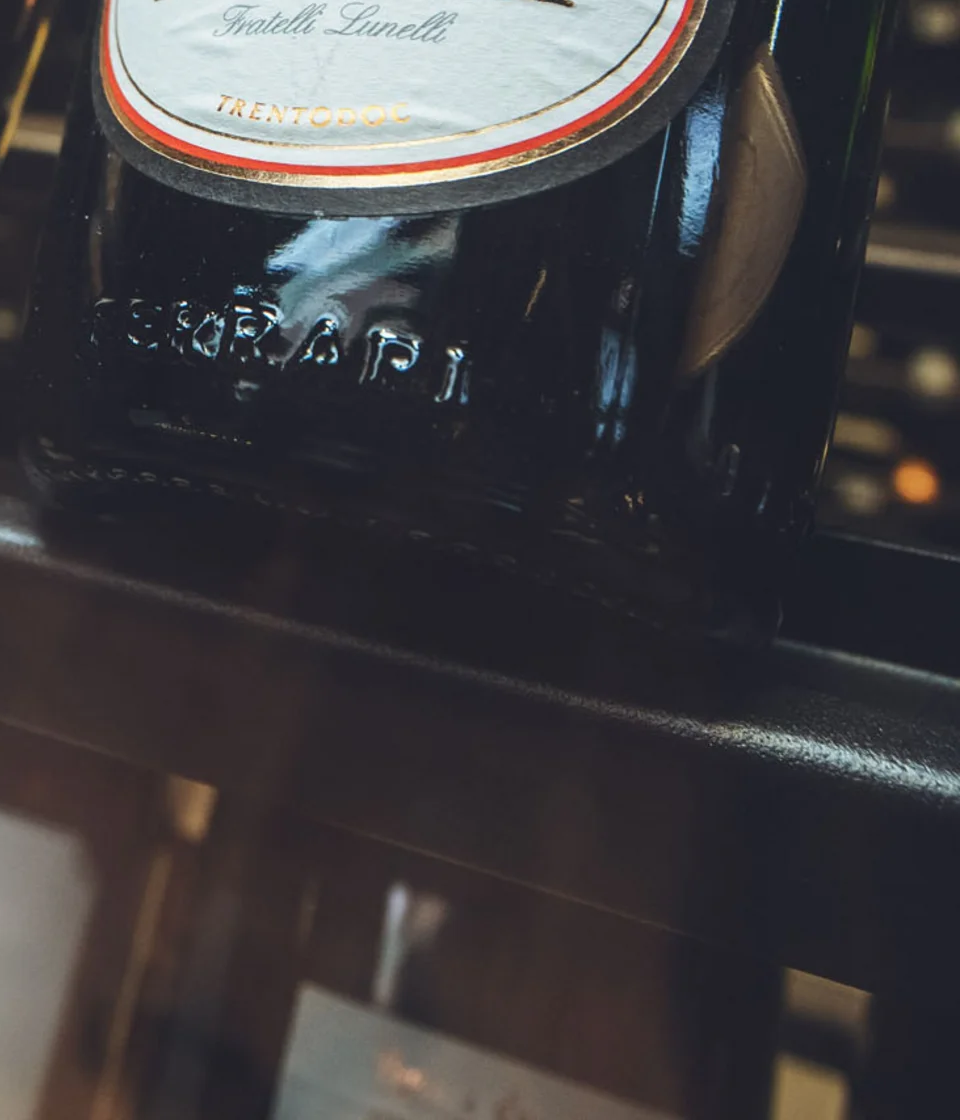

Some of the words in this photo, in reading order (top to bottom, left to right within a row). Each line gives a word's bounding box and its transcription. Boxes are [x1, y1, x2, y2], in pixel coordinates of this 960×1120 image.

[212, 2, 328, 38] Fratelli
[323, 1, 460, 45] Lunelli
[215, 93, 412, 129] TRENTODOC
